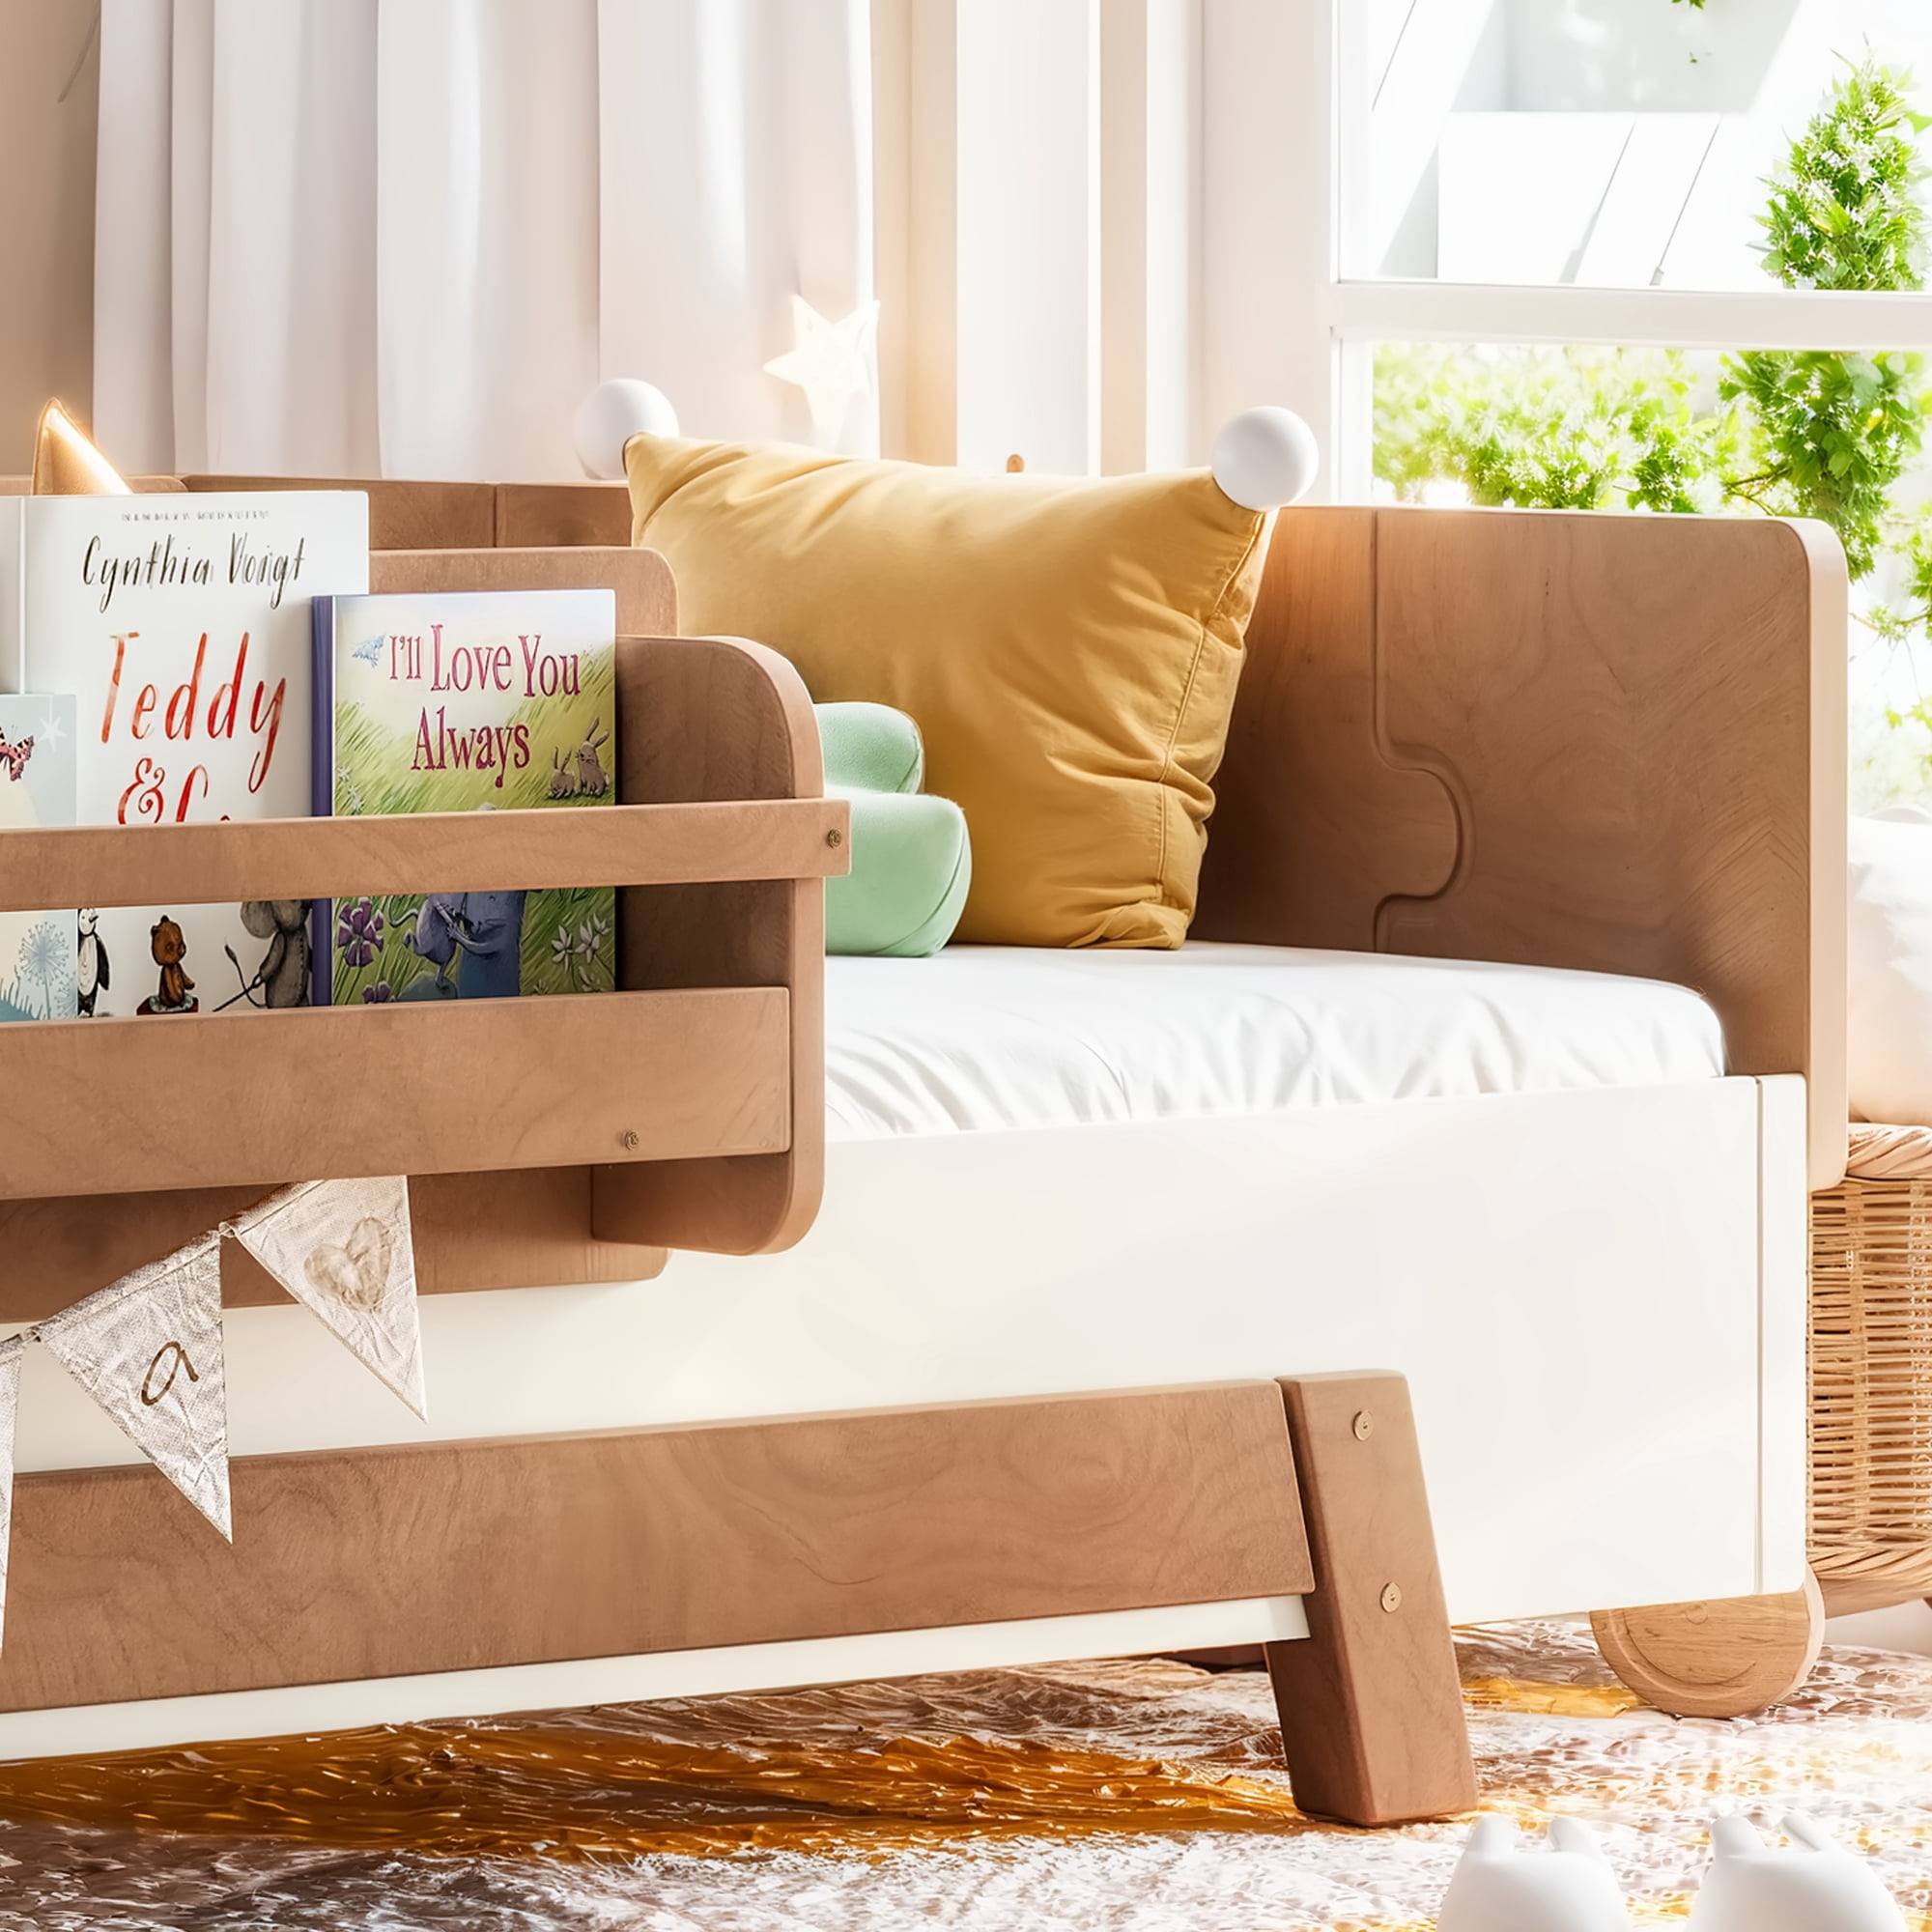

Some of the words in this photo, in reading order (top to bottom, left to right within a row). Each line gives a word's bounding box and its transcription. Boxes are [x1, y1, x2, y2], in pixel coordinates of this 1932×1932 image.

[83, 533, 212, 613] Cynthia
[228, 532, 305, 610] Voigt
[389, 635, 422, 680] I'll
[430, 624, 513, 692] Love
[518, 634, 582, 697] You
[100, 632, 287, 794] Teddy
[411, 705, 531, 788] Always
